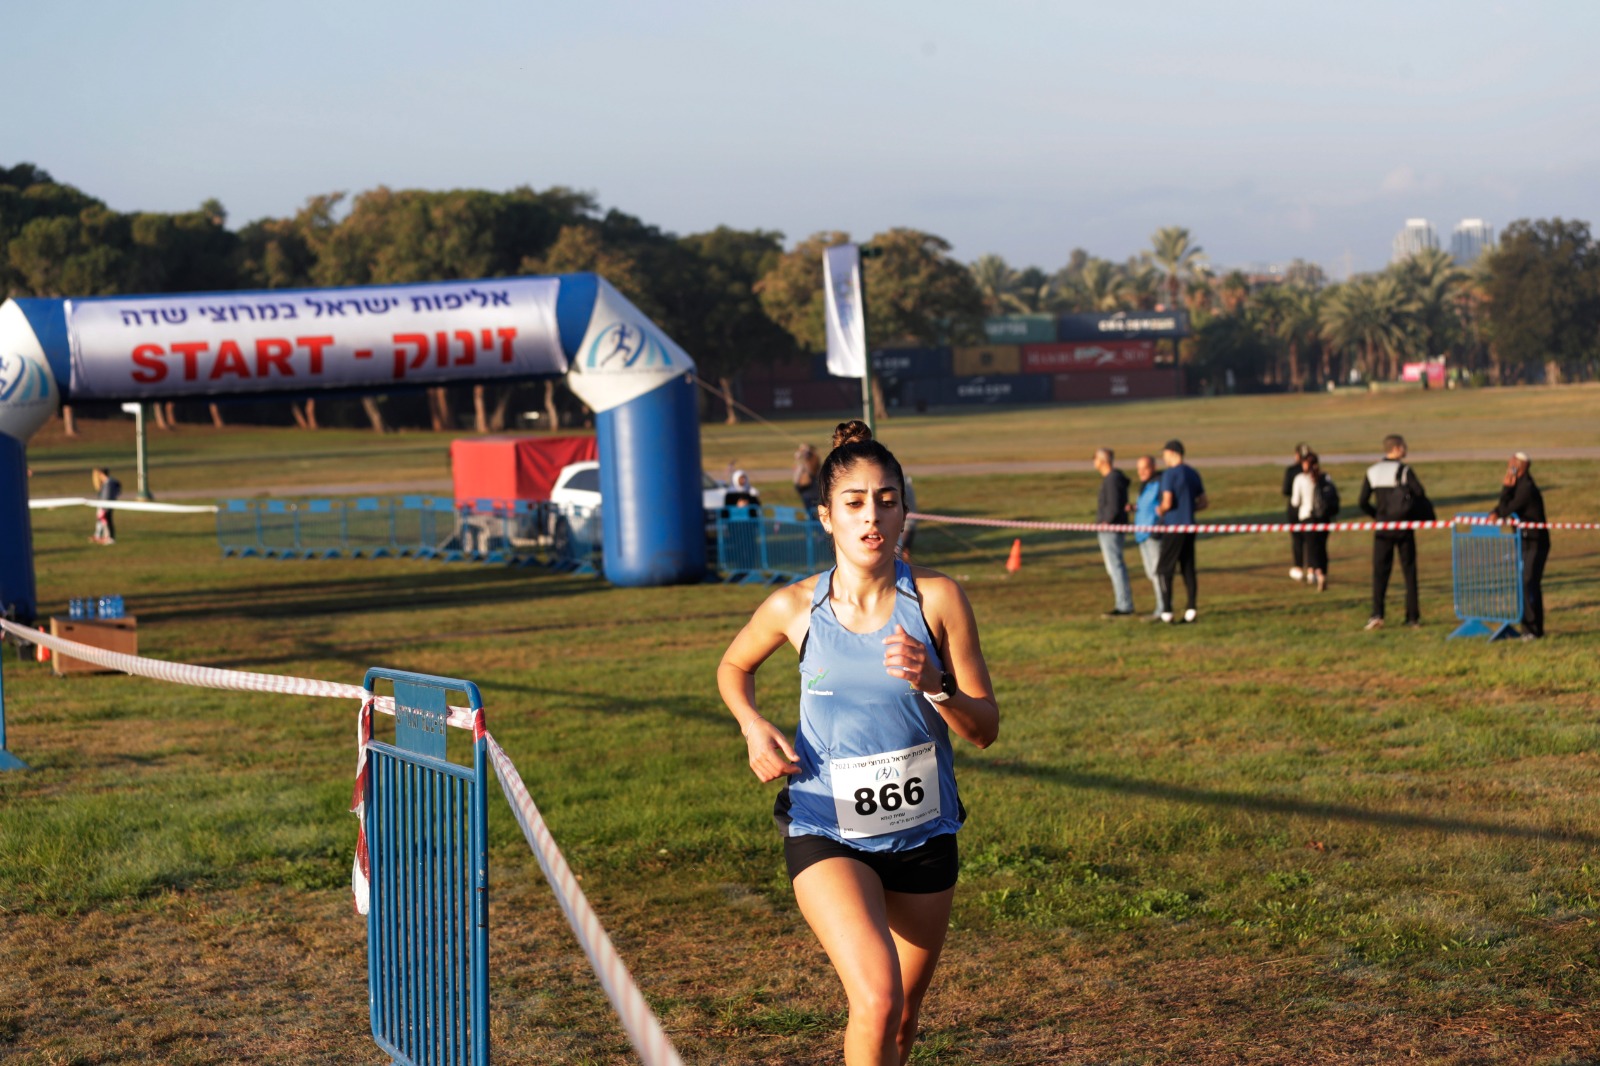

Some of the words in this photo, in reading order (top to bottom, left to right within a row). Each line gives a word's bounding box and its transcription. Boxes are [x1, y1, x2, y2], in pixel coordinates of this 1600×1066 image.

[198, 299, 298, 323] במרוצי
[305, 296, 400, 319] ישראל
[411, 287, 510, 312] אליפות
[120, 305, 188, 328] שדה
[130, 335, 335, 384] START
[392, 327, 518, 379] זינוק
[891, 753, 911, 762] ישראל
[912, 747, 932, 757] אליפות
[854, 777, 925, 816] 866
